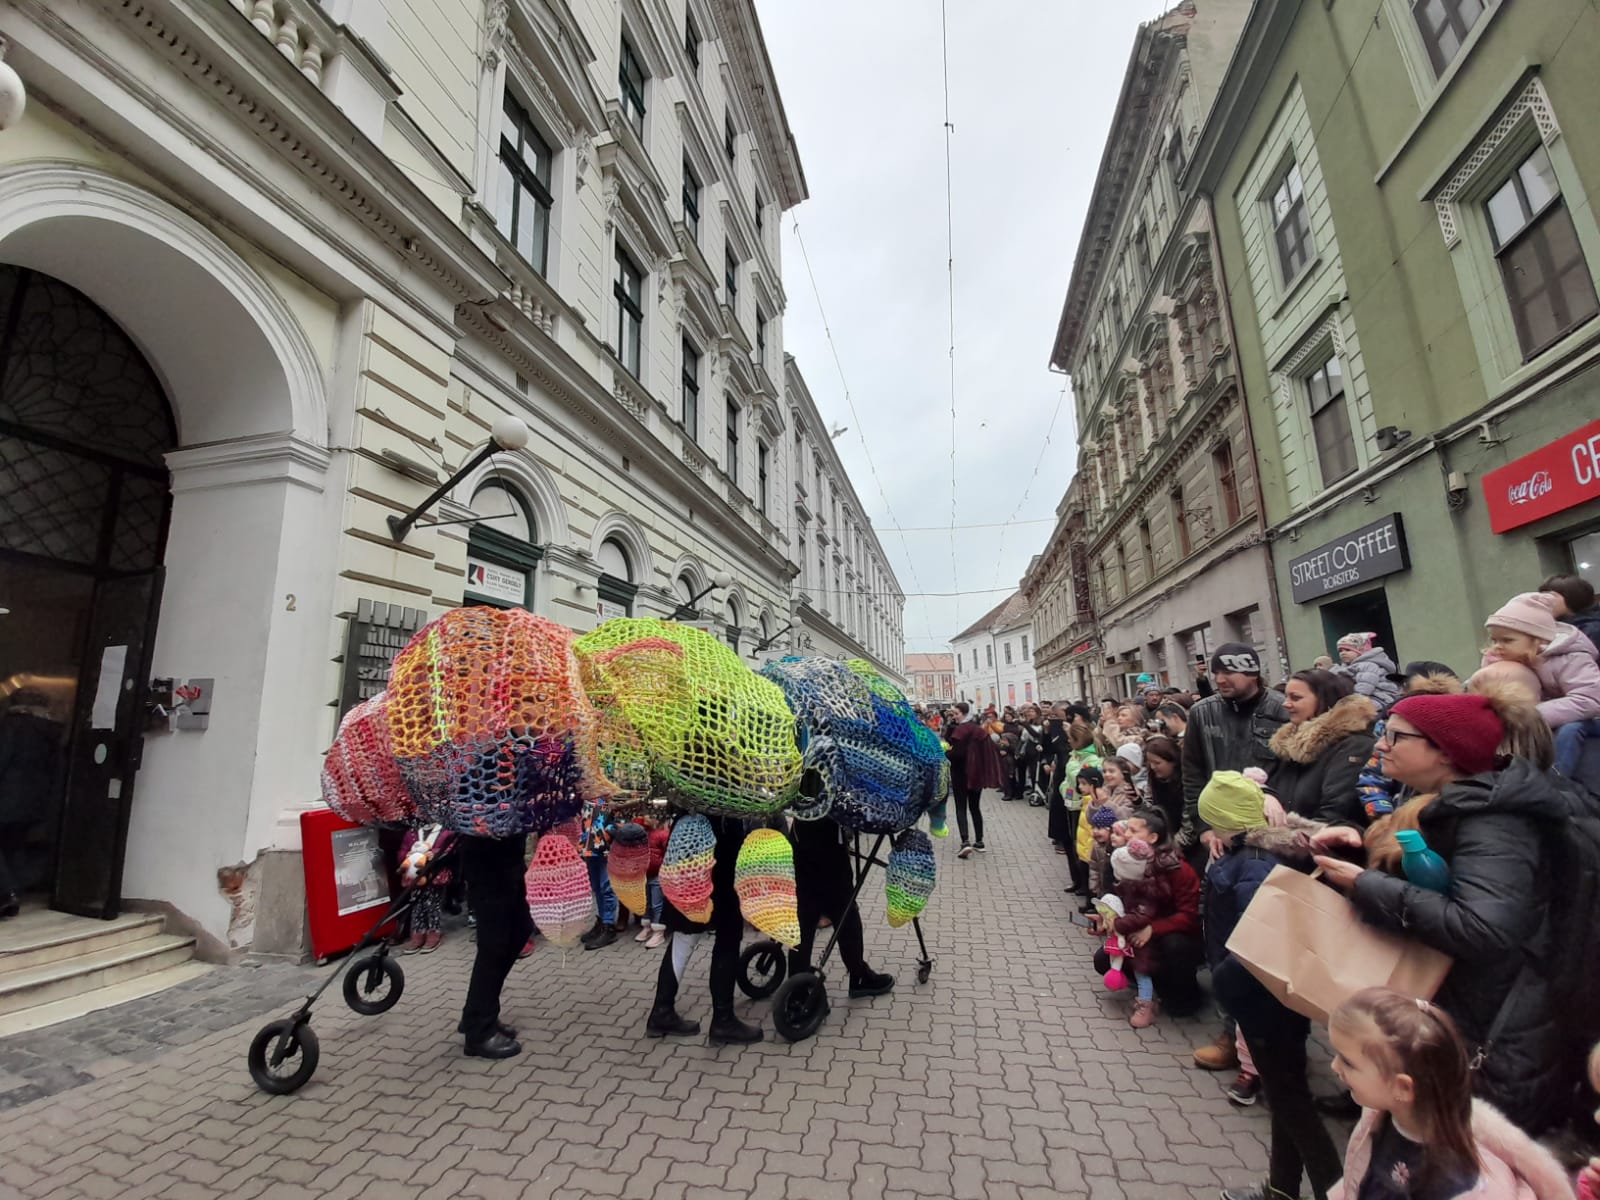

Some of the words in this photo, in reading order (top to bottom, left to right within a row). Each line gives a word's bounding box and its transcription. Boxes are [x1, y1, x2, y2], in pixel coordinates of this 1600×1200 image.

[1292, 551, 1330, 586] STREET
[1332, 523, 1396, 570] COFFEE
[1322, 567, 1360, 590] ROASTERS
[286, 593, 297, 612] 2
